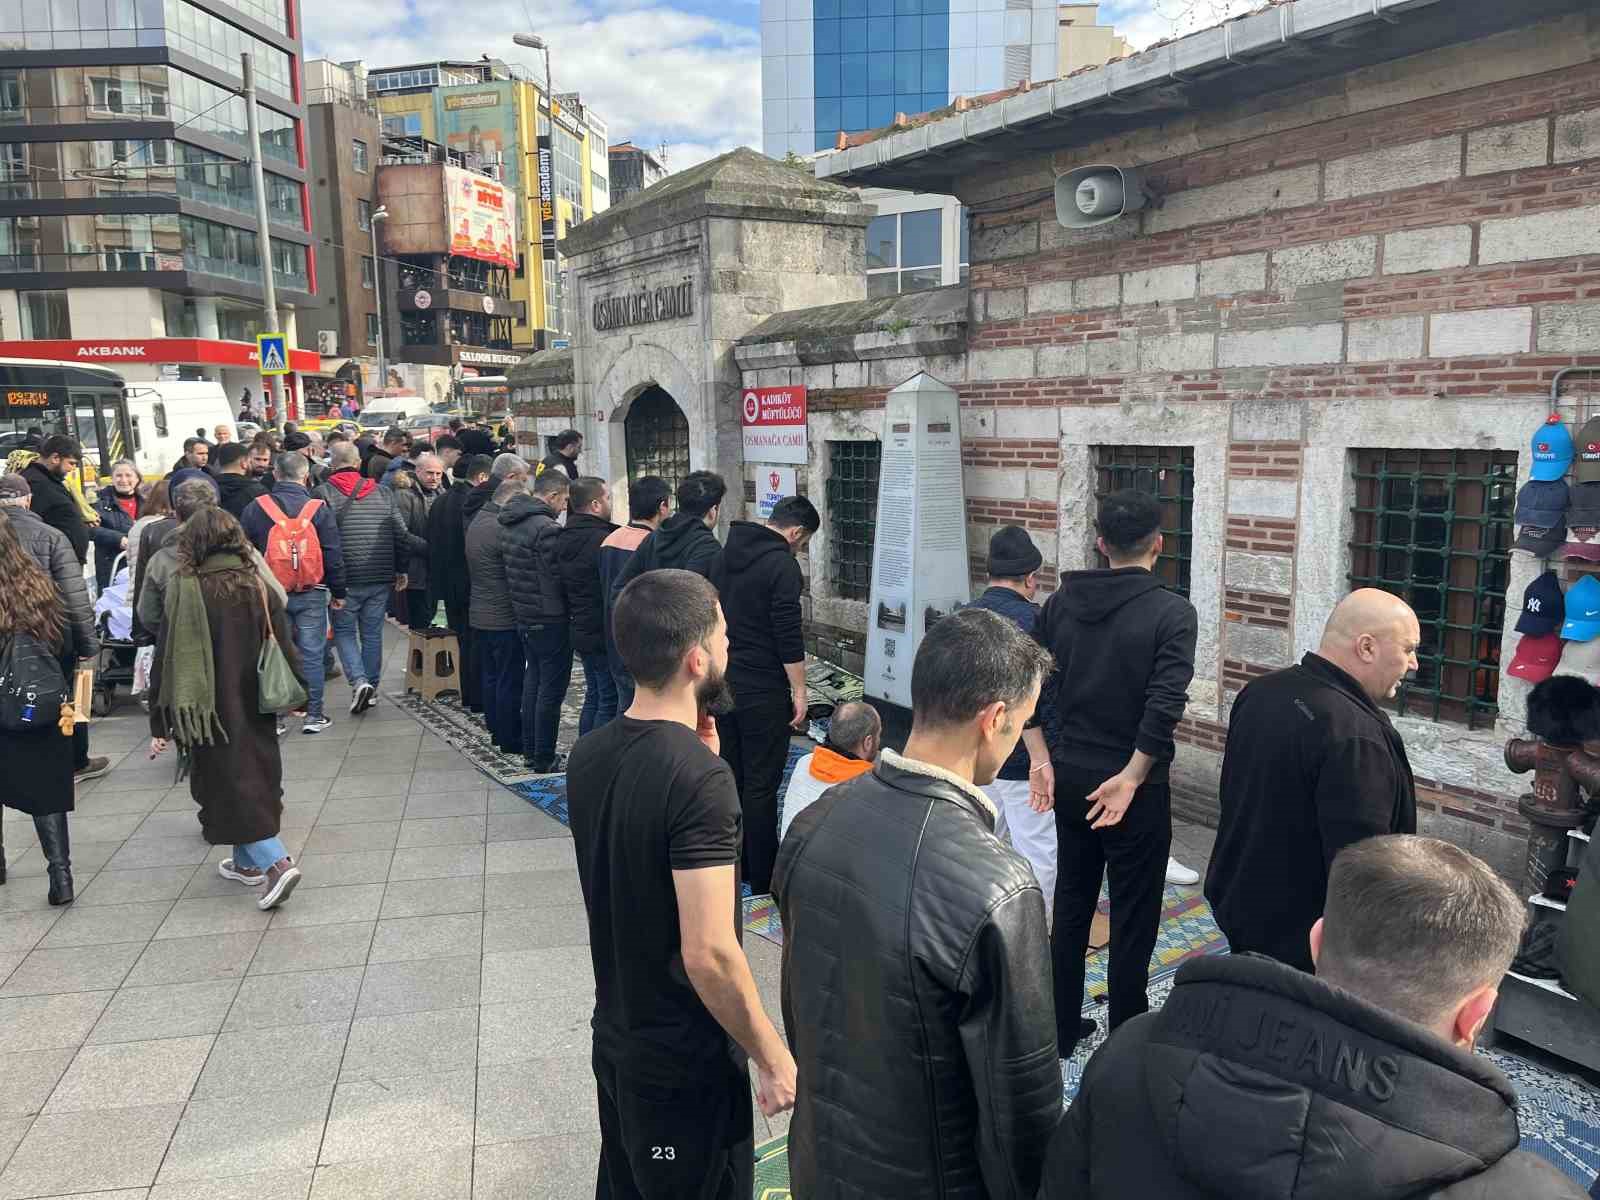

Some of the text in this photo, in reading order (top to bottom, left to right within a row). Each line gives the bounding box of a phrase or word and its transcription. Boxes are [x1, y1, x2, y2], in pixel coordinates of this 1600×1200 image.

[77, 346, 146, 356] AKBANK
[761, 392, 792, 405] KADIKÖY
[1236, 1010, 1400, 1102] JEANS
[651, 1146, 676, 1160] 23
